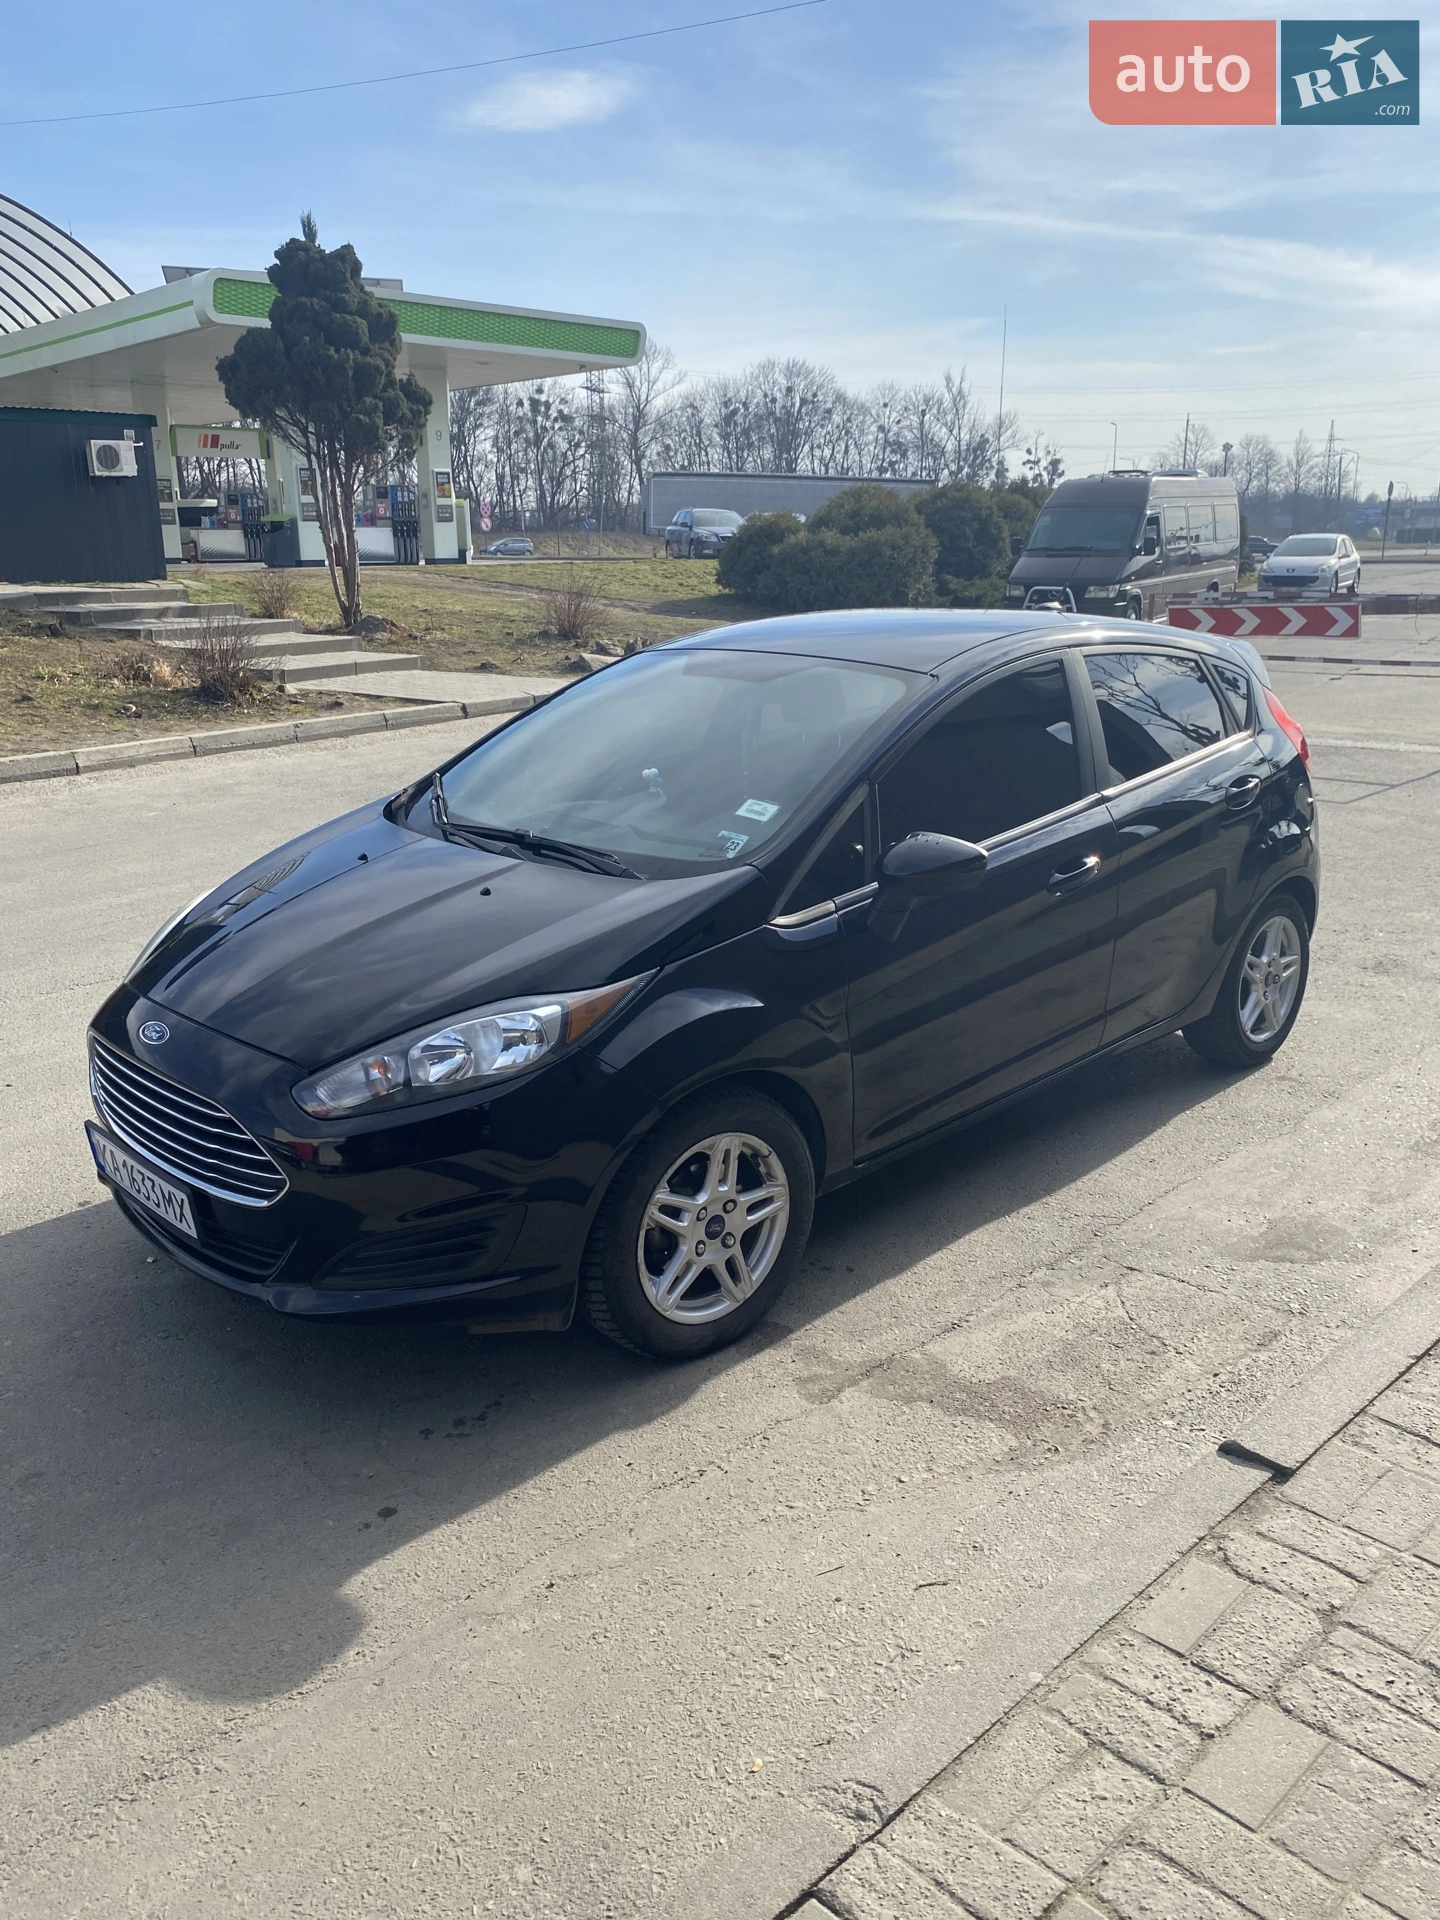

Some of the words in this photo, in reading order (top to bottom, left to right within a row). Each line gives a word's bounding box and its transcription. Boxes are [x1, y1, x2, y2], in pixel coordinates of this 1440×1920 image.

[435, 430, 442, 441] 9
[154, 439, 161, 450] 7
[219, 440, 242, 451] pulls
[725, 840, 740, 852] 23
